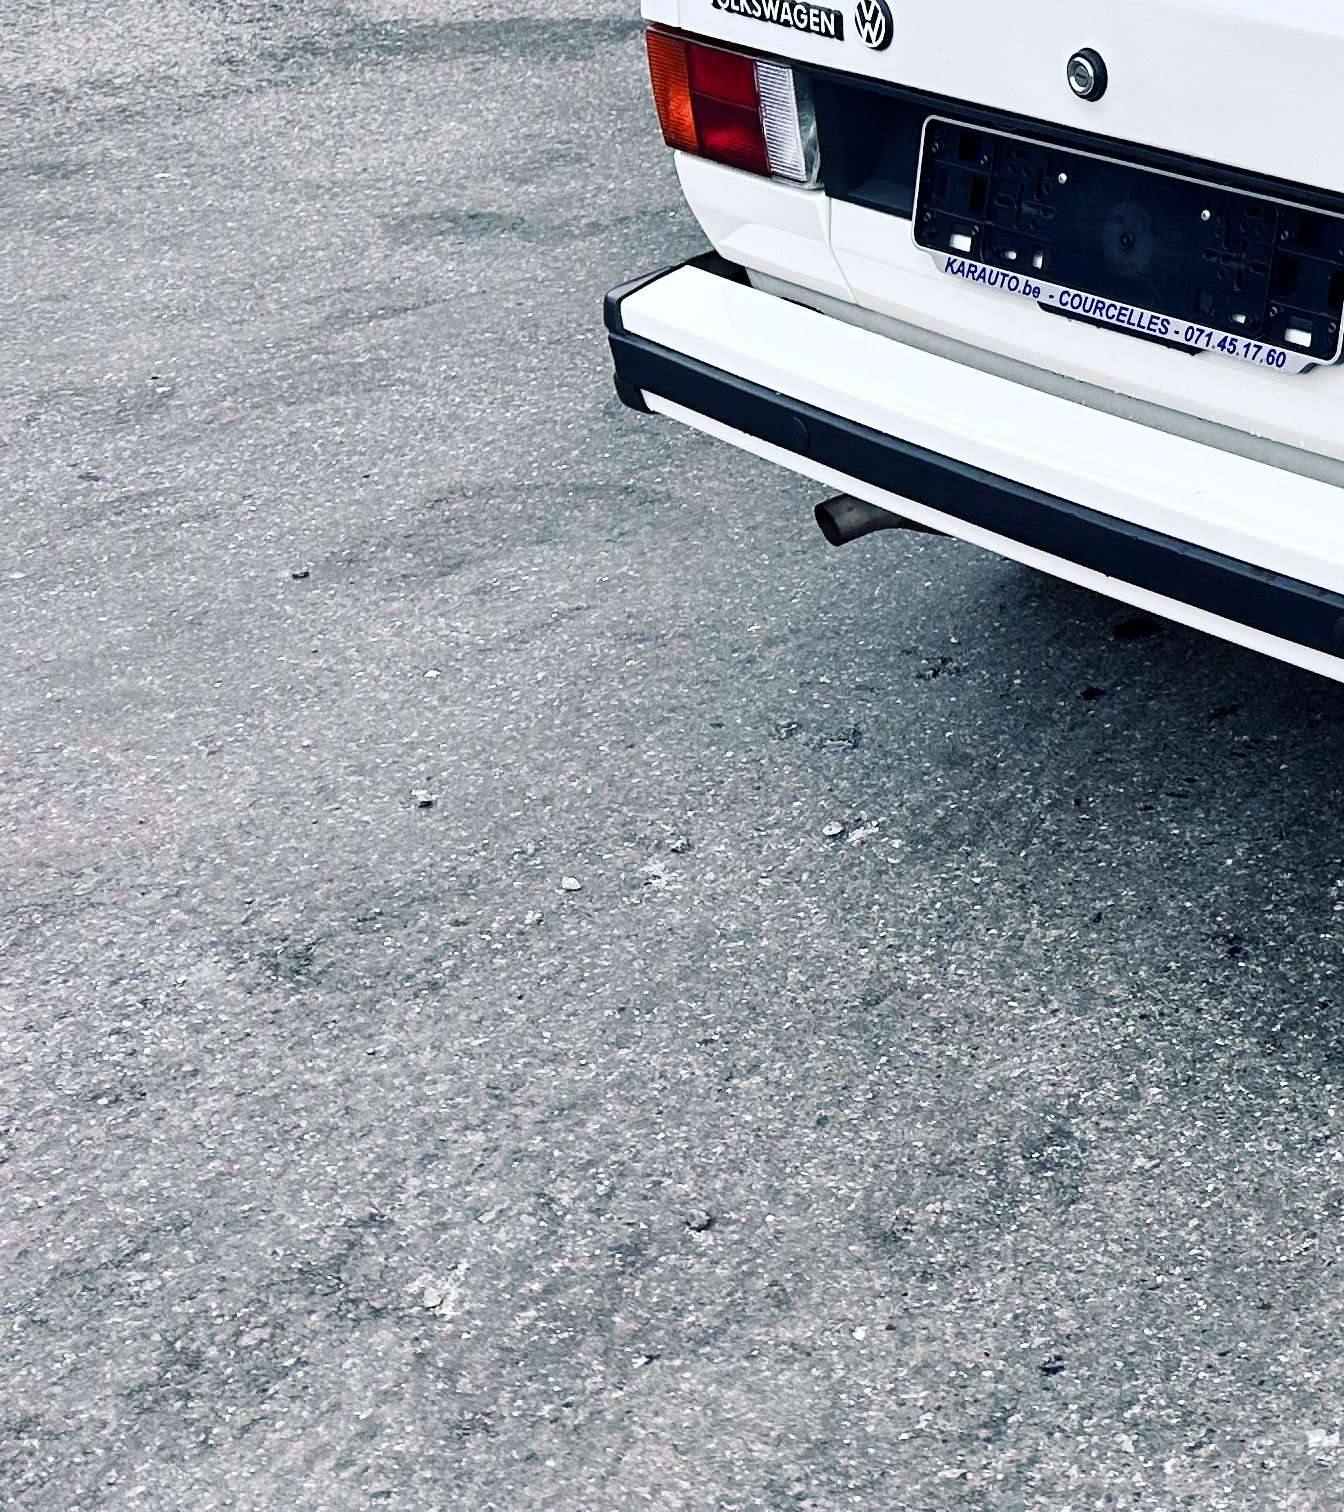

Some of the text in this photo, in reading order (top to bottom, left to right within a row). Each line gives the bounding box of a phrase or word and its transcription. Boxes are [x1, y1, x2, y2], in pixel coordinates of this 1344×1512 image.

[944, 257, 1041, 299] KARAUTO.be
[1058, 290, 1171, 336] COURCELLES
[1184, 325, 1287, 369] 071.45.17.60
